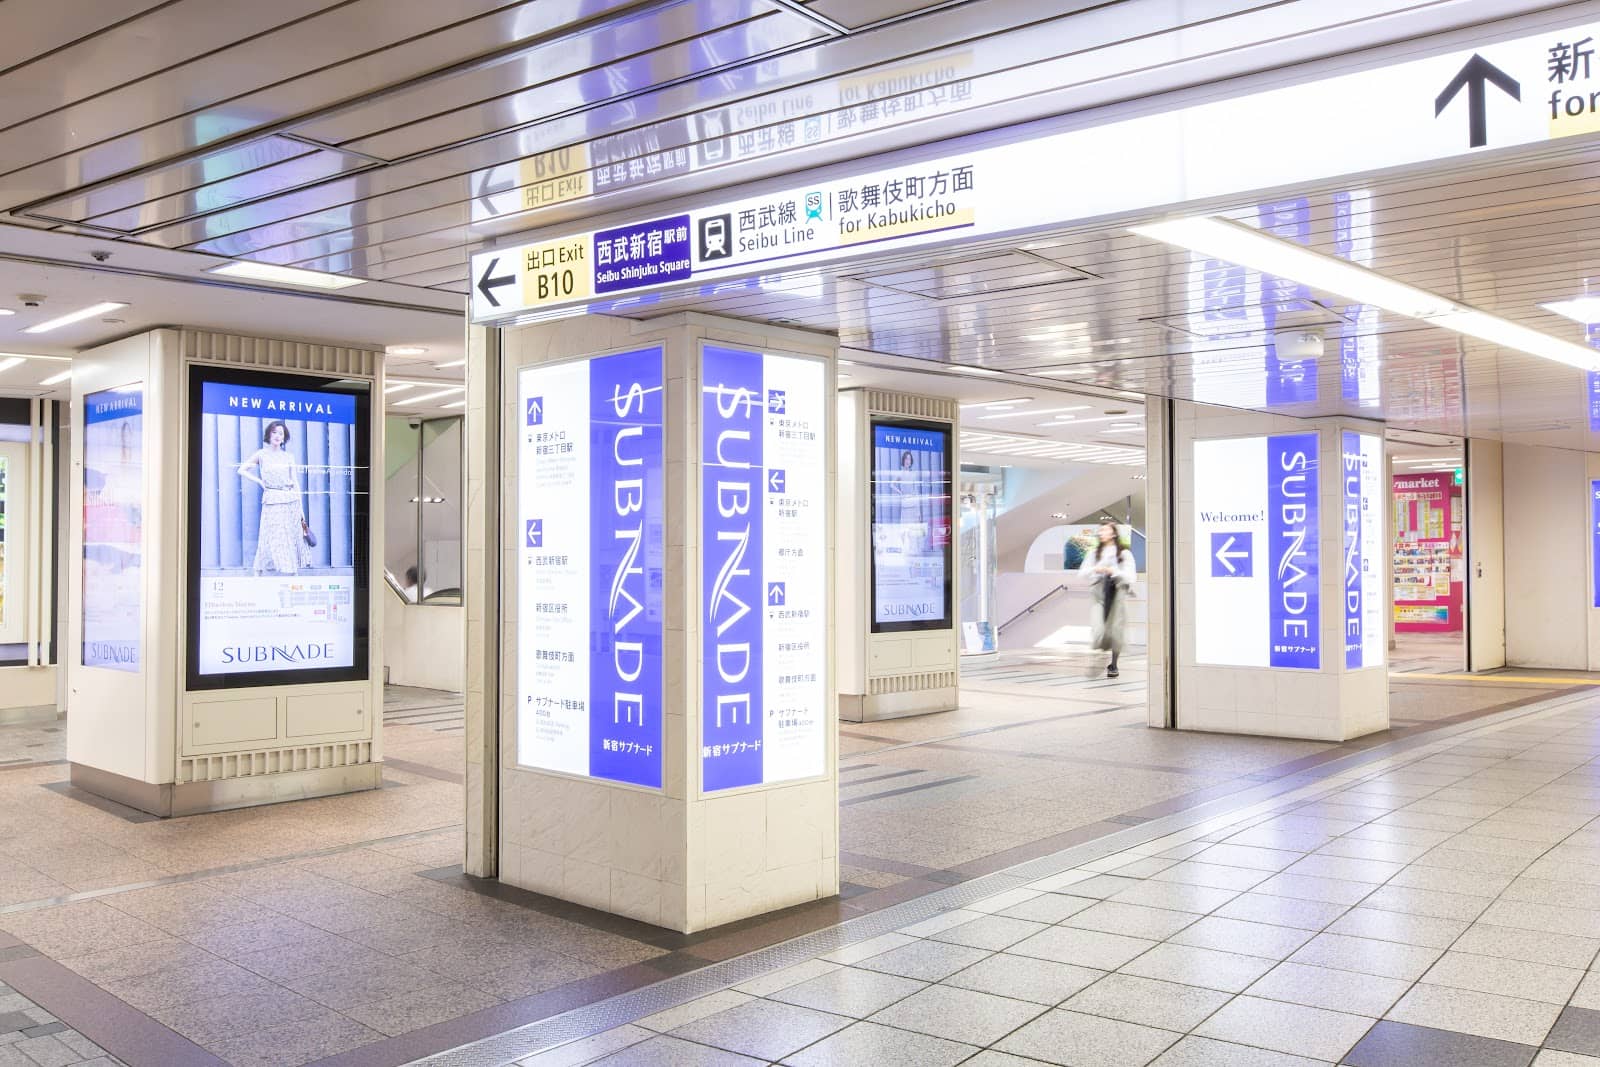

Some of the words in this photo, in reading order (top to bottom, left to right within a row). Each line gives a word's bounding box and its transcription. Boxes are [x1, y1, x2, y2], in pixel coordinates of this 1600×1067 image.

[1548, 89, 1600, 120] for
[807, 195, 820, 206] SS
[838, 164, 975, 214] 歌舞伎町方面
[738, 200, 797, 233] 西武線
[839, 216, 863, 235] for
[868, 200, 956, 230] Kabukicho
[738, 232, 779, 252] Seibu
[784, 227, 815, 245] Line
[527, 248, 555, 272] 出口
[559, 243, 584, 263] Exit
[596, 270, 620, 284] Seibu
[621, 262, 658, 281] Shinjuku
[659, 258, 690, 276] Square
[537, 269, 574, 300] B10
[229, 396, 261, 409] NEW
[267, 399, 333, 415] ARRIVAL
[1200, 509, 1265, 523] Welcome!
[609, 382, 644, 727] SUBNADE
[709, 383, 751, 728] SUBNADE
[1278, 451, 1308, 638] SUBNADE
[221, 642, 335, 664] SUBNADE
